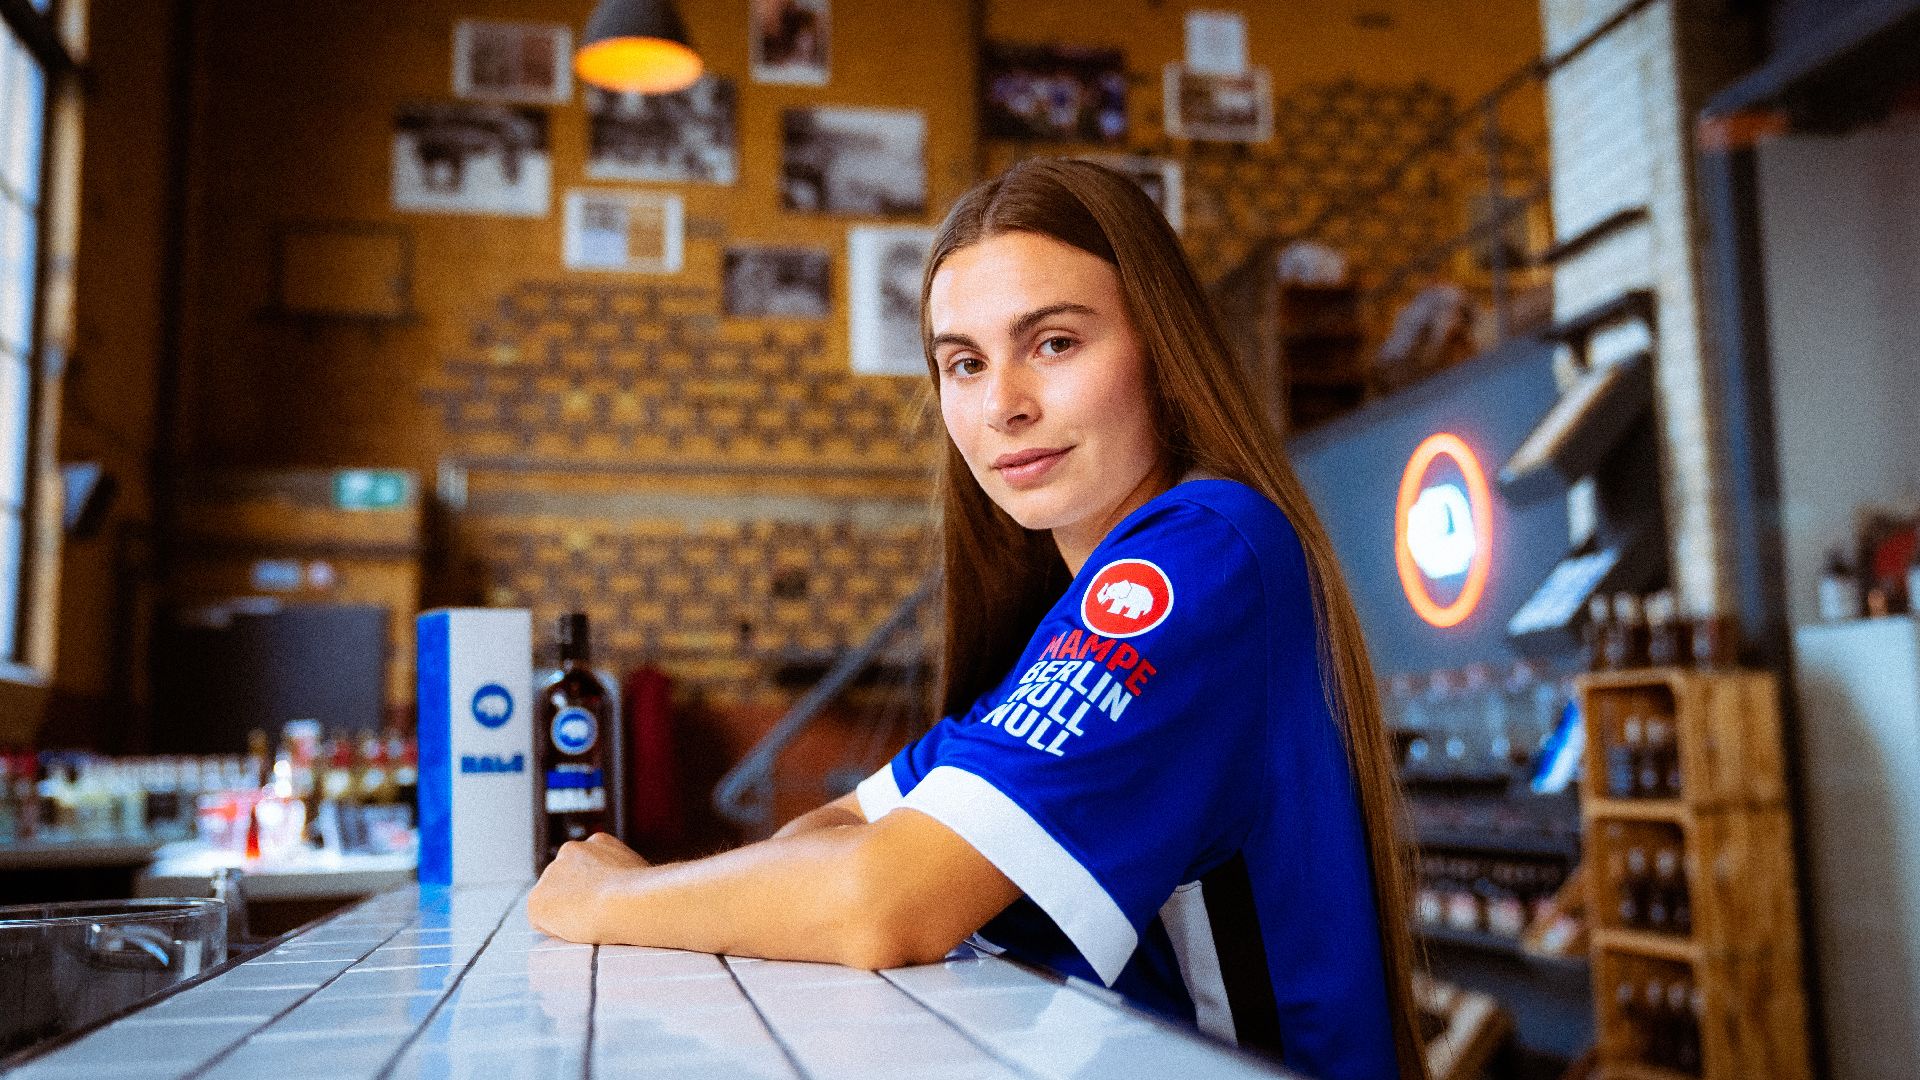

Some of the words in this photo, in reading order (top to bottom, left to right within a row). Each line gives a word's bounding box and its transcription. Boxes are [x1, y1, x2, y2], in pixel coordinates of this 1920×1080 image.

[1019, 660, 1132, 722] BERLIN
[1039, 629, 1157, 696] MAMPE
[981, 702, 1069, 757] NULL
[1007, 682, 1091, 737] NULL
